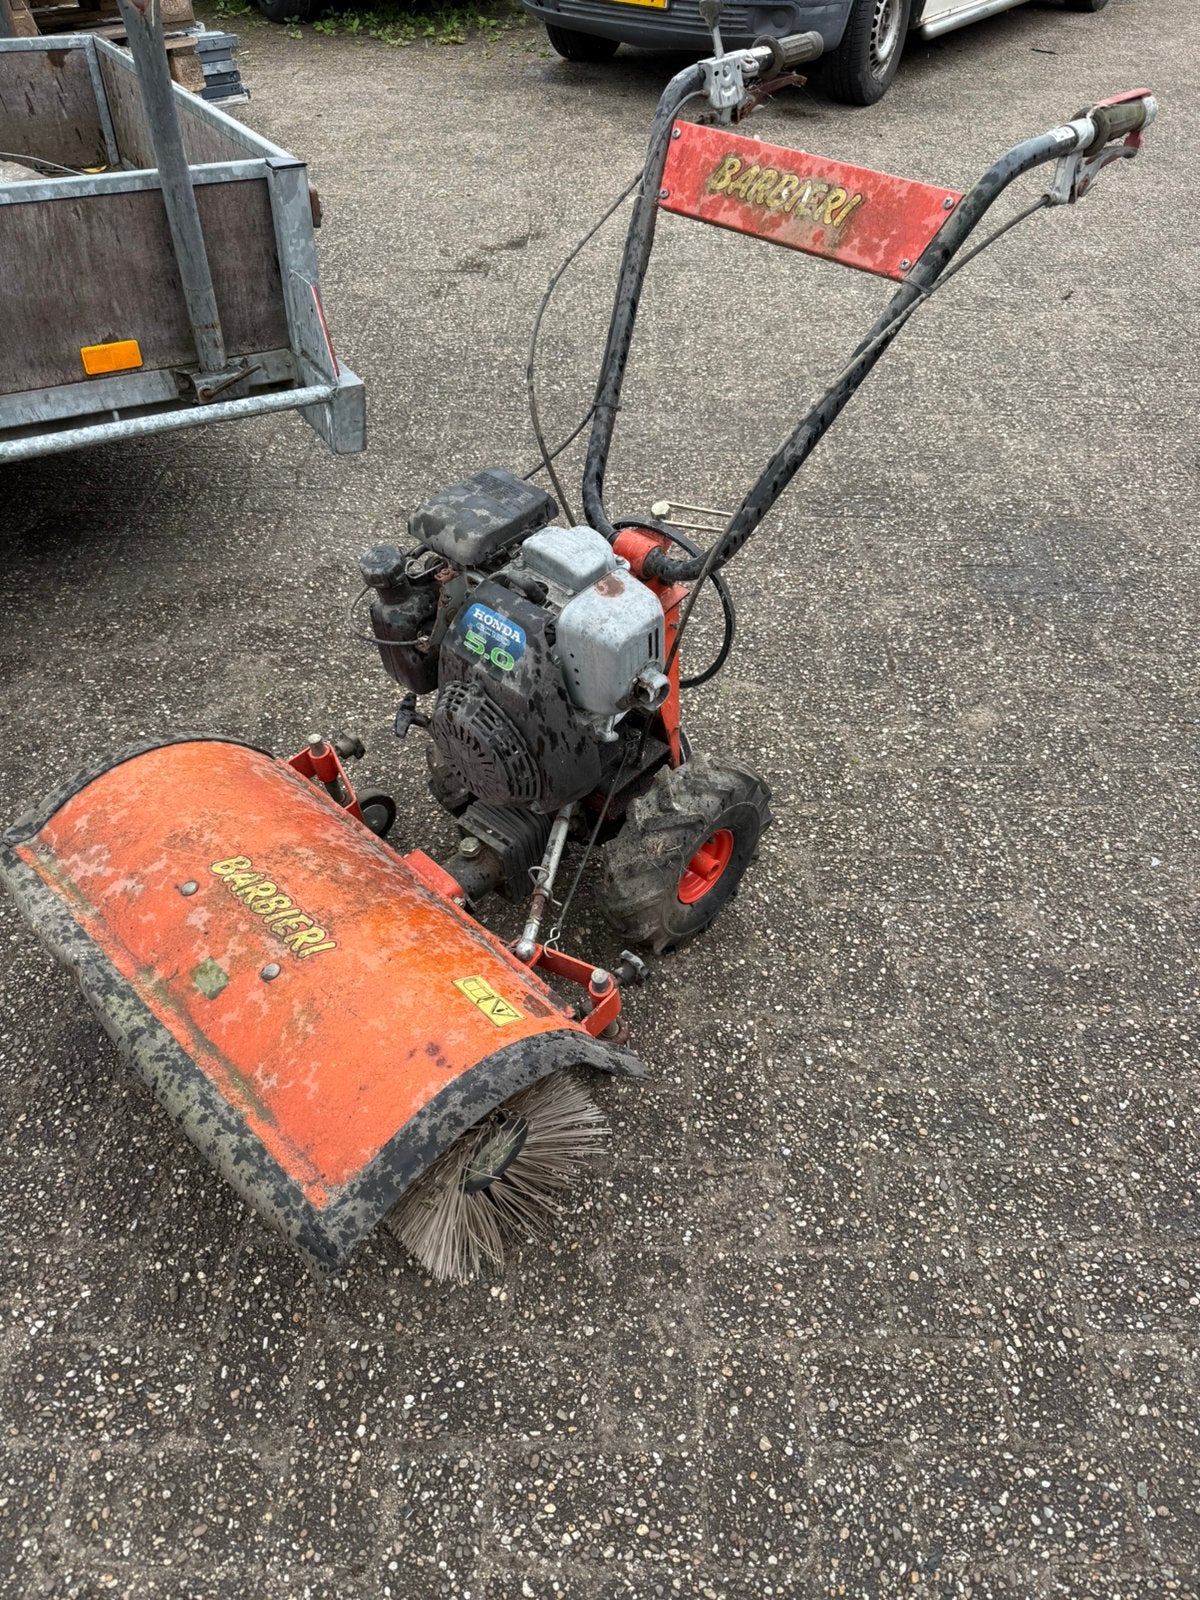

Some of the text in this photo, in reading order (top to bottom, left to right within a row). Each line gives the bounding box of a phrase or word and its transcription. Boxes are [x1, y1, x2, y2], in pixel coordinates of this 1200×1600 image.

[708, 153, 865, 227] BARBIERI
[463, 630, 515, 672] 5.0
[473, 608, 521, 643] HONDA
[209, 855, 338, 959] BARBIERI
